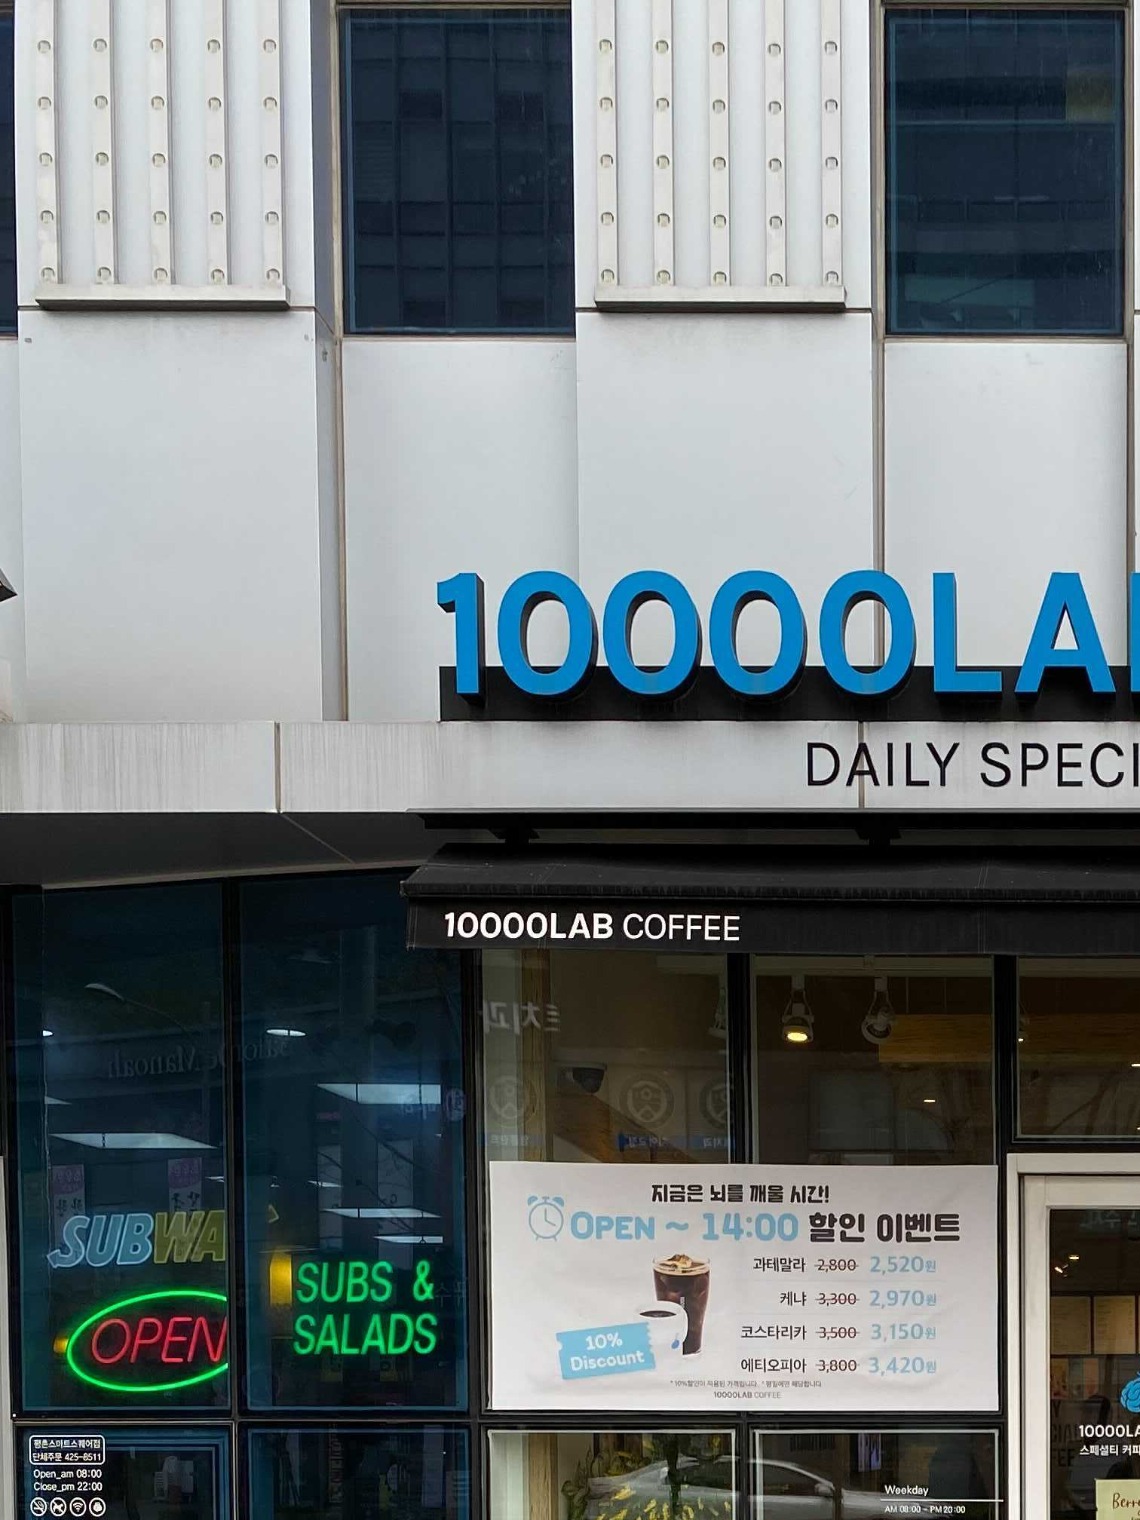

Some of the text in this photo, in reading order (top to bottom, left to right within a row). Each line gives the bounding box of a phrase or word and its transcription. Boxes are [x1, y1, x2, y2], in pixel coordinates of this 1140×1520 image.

[805, 742, 960, 788] DAILY
[444, 911, 741, 942] 10000LAB COFFEE
[651, 1184, 830, 1205] 지금은 뇌를 깨울 시간!
[569, 1210, 656, 1241] OPEN
[702, 1212, 799, 1242] 14:00
[808, 1211, 866, 1243] 할인
[876, 1212, 961, 1244] 이벤트
[46, 1210, 227, 1269] SUBWA
[752, 1256, 937, 1275] 과테말라 2,800 2,520원
[296, 1260, 393, 1303] SUBS
[412, 1259, 436, 1302] &
[779, 1290, 937, 1309] 케냐 3,300 2,970원
[91, 1315, 228, 1364] OPEN
[292, 1313, 438, 1358] SALADS
[585, 1331, 623, 1351] 10%
[740, 1323, 937, 1342] 코스타리카 3,500 3,150원
[569, 1350, 646, 1372] Discount
[740, 1357, 937, 1377] 에티오피아 3,800 3,420원
[76, 1469, 102, 1479] 08:00
[77, 1481, 103, 1491] 22:00
[884, 1484, 929, 1497] Weekday
[884, 1505, 898, 1514] AM
[929, 1505, 943, 1514] PM
